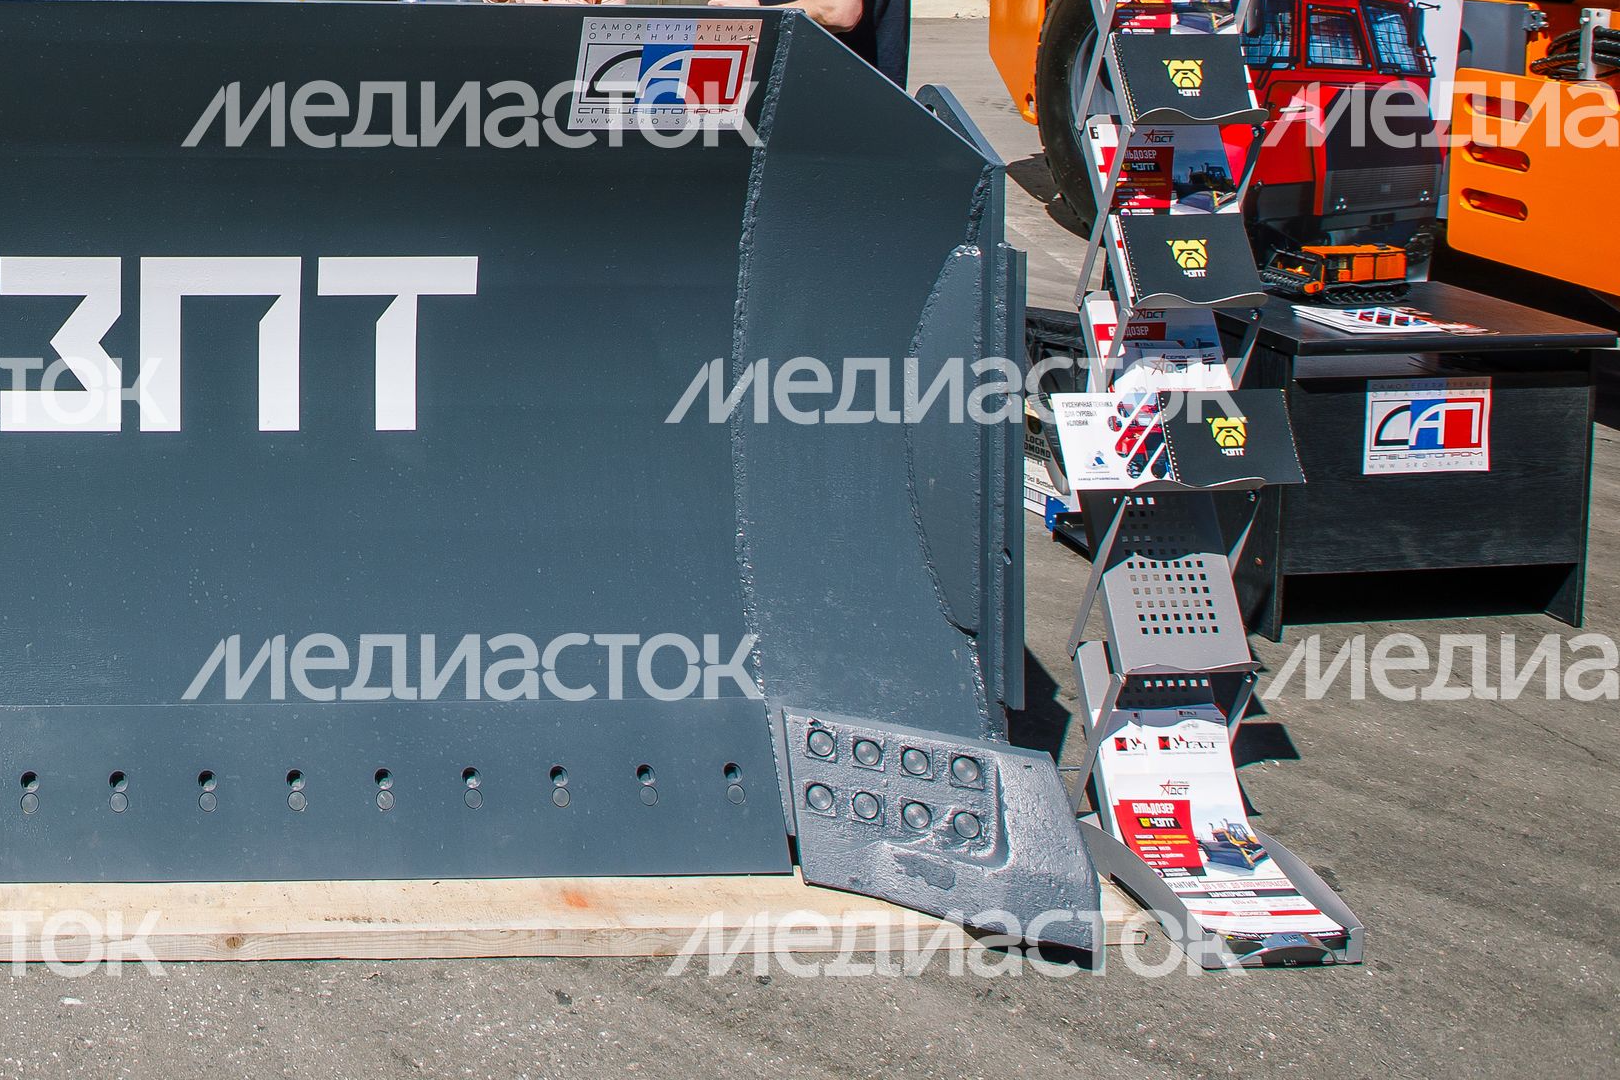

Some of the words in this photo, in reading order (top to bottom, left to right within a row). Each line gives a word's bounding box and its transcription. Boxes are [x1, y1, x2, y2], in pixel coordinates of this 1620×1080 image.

[589, 22, 754, 32] САМОРЕГУЛИРУЕМАЯ
[588, 32, 754, 42] ОРГАНИЗАЦИЯ
[577, 107, 739, 115] СПЕЦАВТОПРОМ
[1024, 440, 1051, 459] OMOND
[1167, 880, 1199, 890] РАНТИЯ
